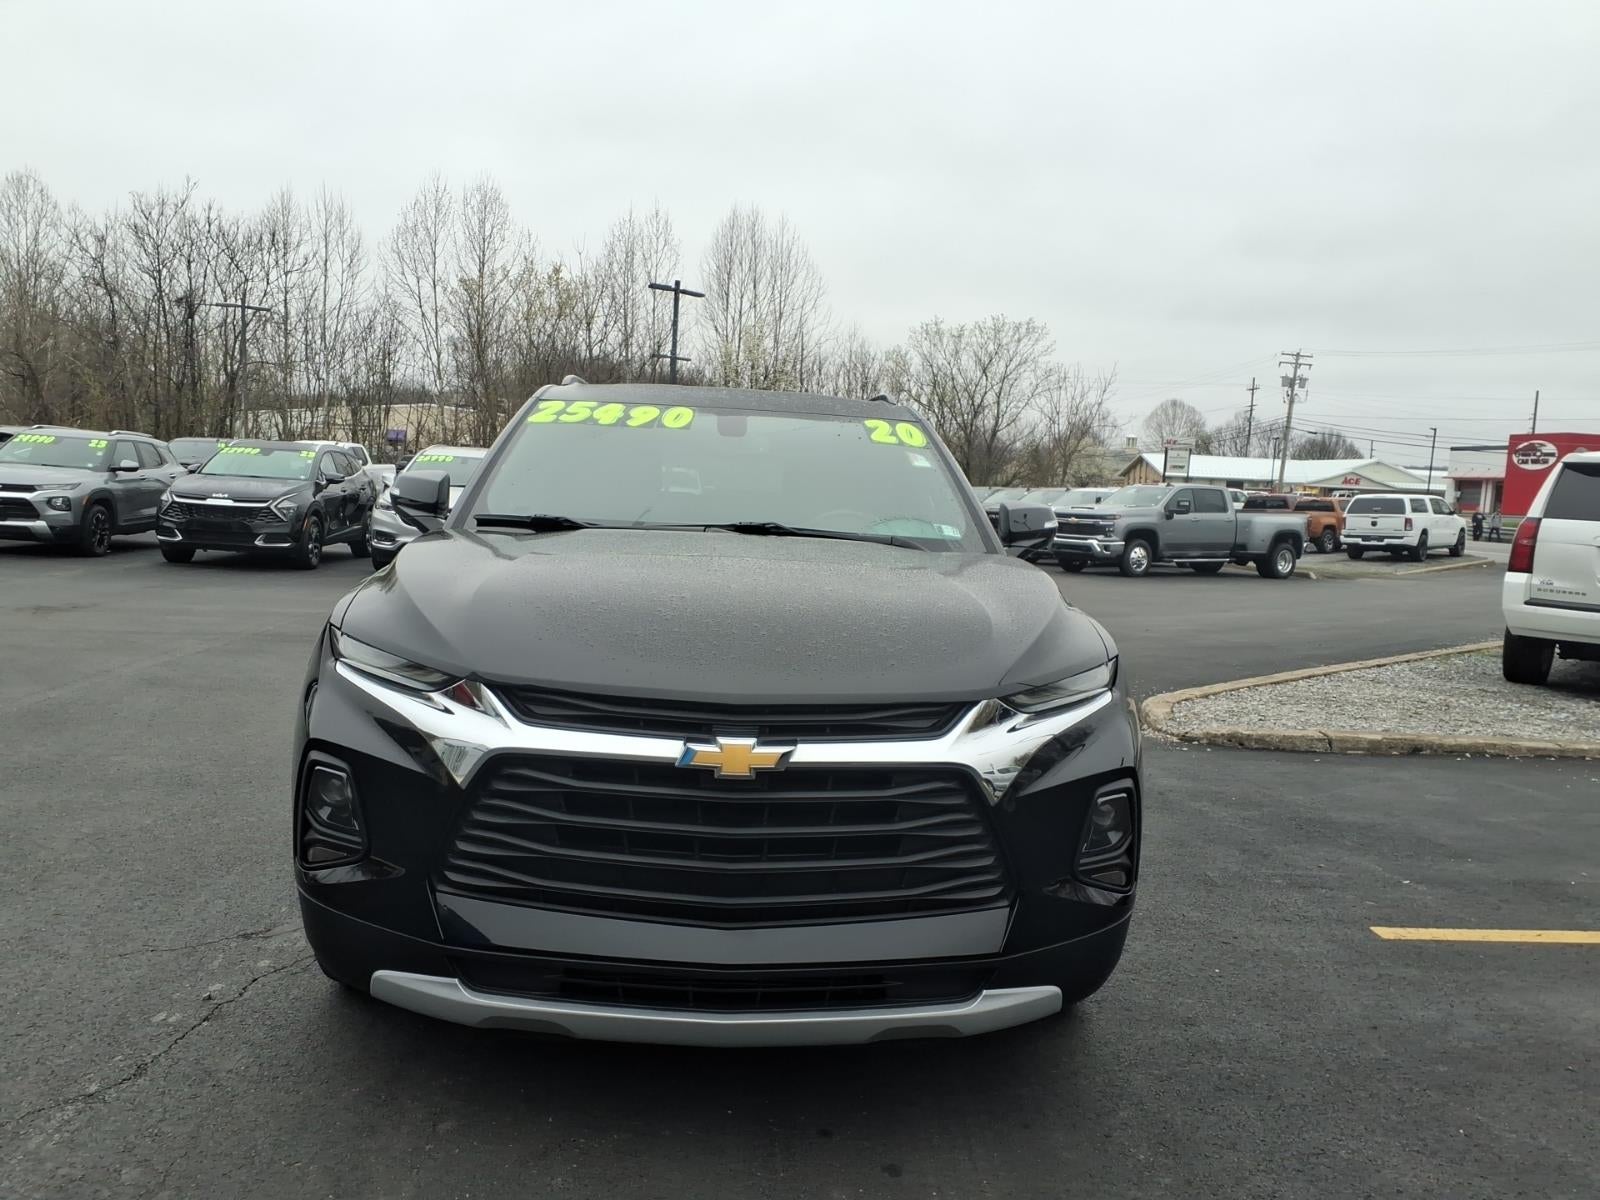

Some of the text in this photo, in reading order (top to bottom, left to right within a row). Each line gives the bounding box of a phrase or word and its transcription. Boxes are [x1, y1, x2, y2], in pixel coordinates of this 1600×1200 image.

[527, 400, 694, 428] 25490
[864, 419, 927, 447] 20
[1342, 475, 1361, 485] ACE
